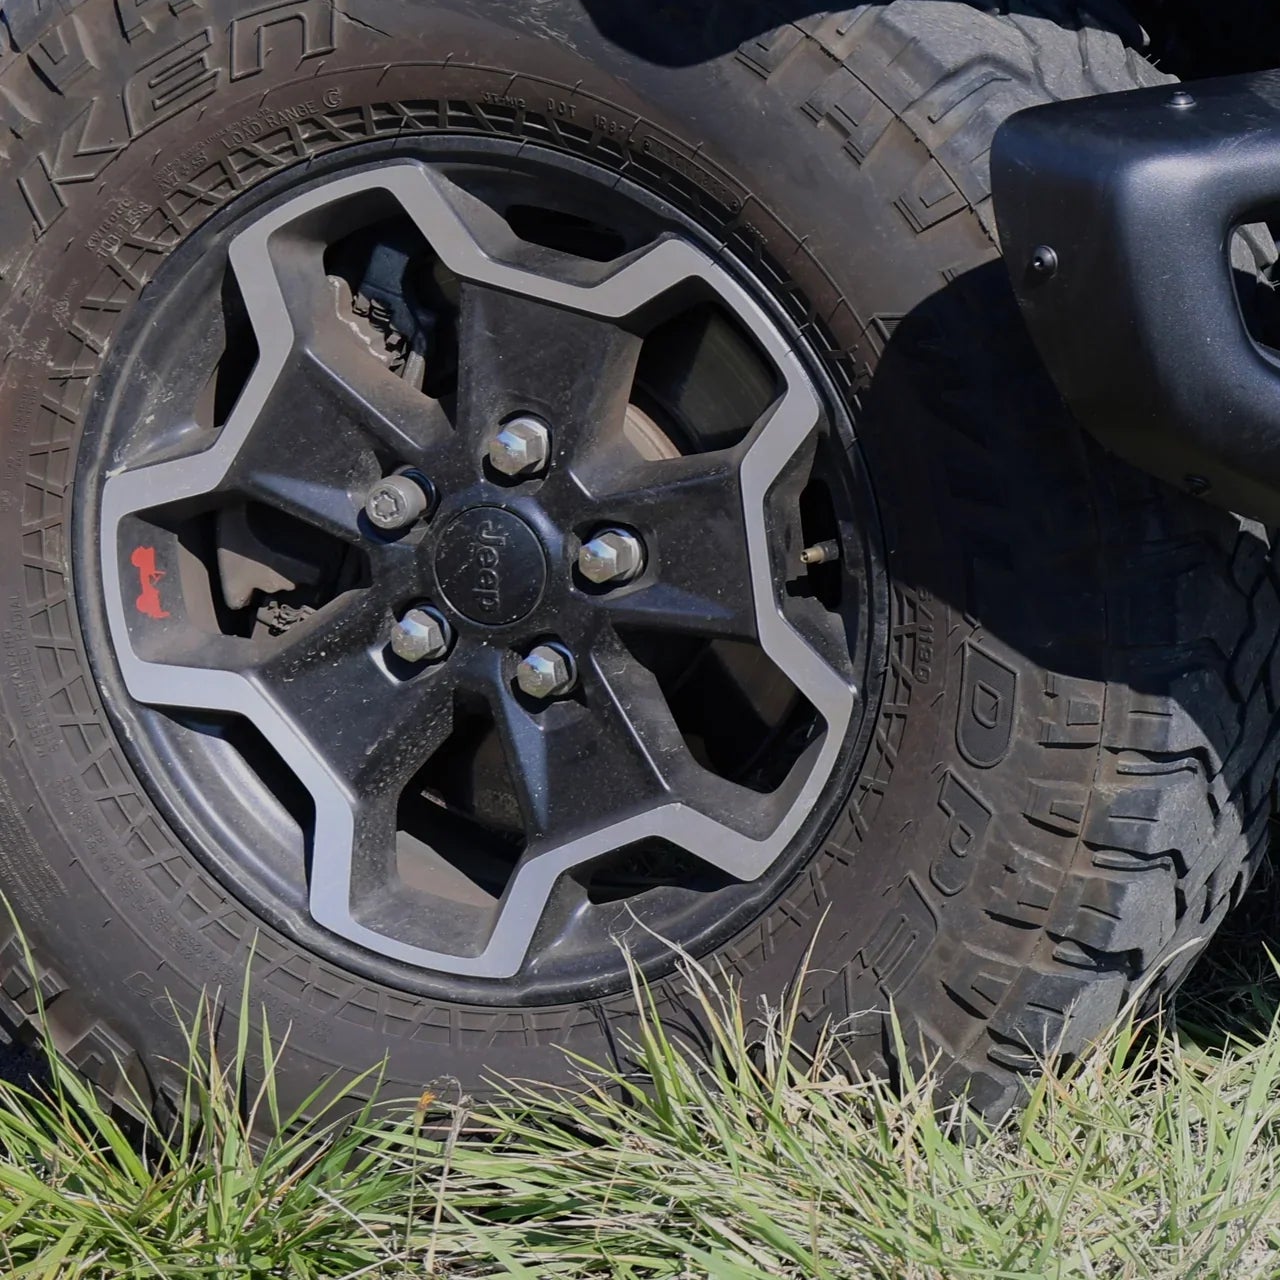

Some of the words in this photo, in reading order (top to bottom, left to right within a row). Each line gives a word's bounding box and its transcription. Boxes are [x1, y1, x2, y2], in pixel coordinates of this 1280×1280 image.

[220, 117, 264, 152] LOAD
[265, 95, 319, 132] RANGE
[545, 96, 578, 117] DOT
[473, 519, 510, 613] Jeep
